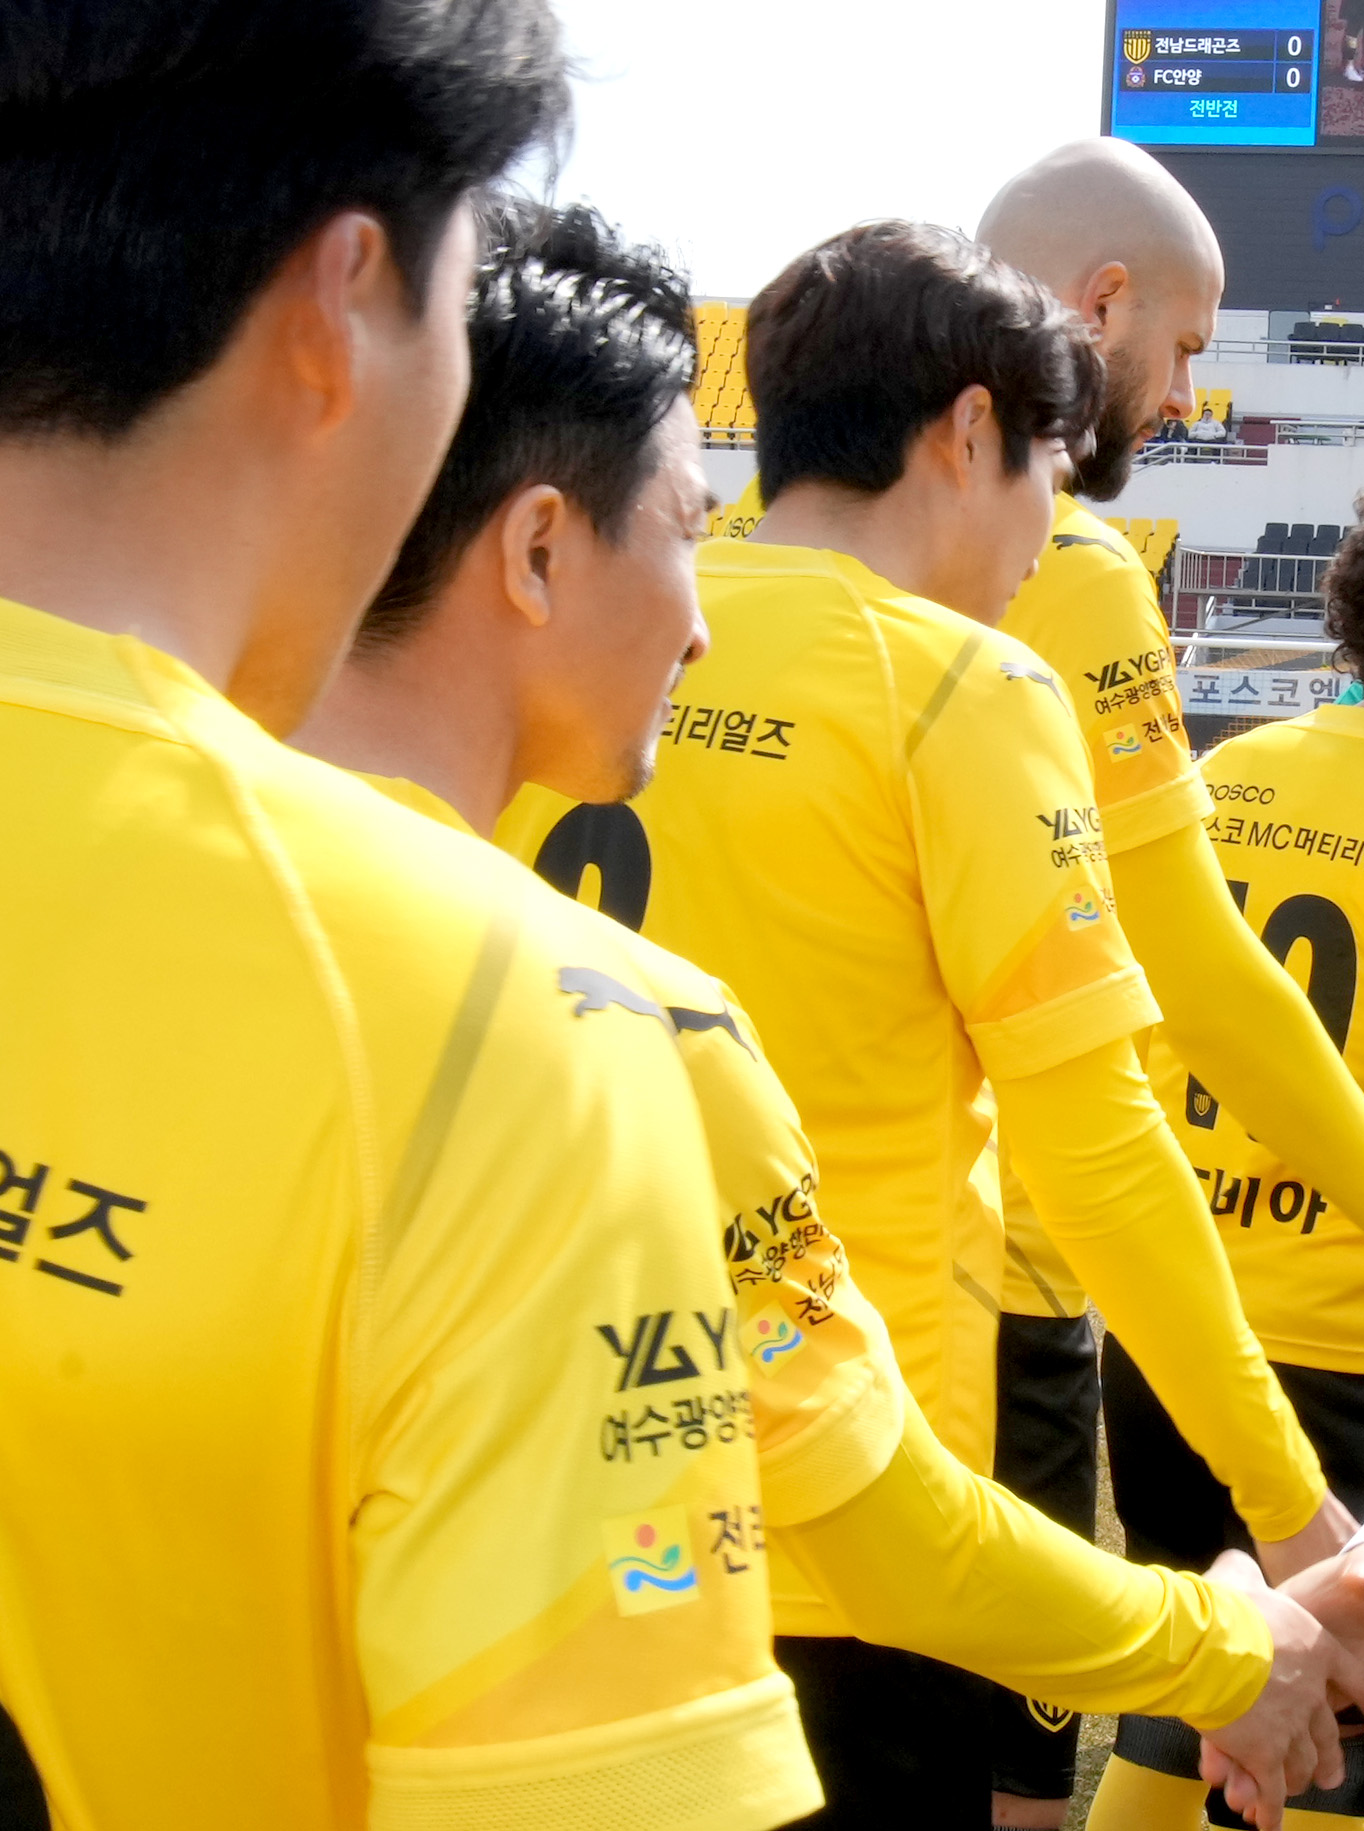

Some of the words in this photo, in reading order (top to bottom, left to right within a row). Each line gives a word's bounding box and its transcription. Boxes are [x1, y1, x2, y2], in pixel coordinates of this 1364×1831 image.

[1154, 37, 1241, 54] 전남드래곤즈
[1287, 36, 1302, 56] 0
[1154, 69, 1202, 86] FC안양
[1286, 68, 1301, 88] 0
[1189, 100, 1238, 118] 전반전
[1193, 1166, 1327, 1235] 비아
[600, 1391, 755, 1463] 여수광양
